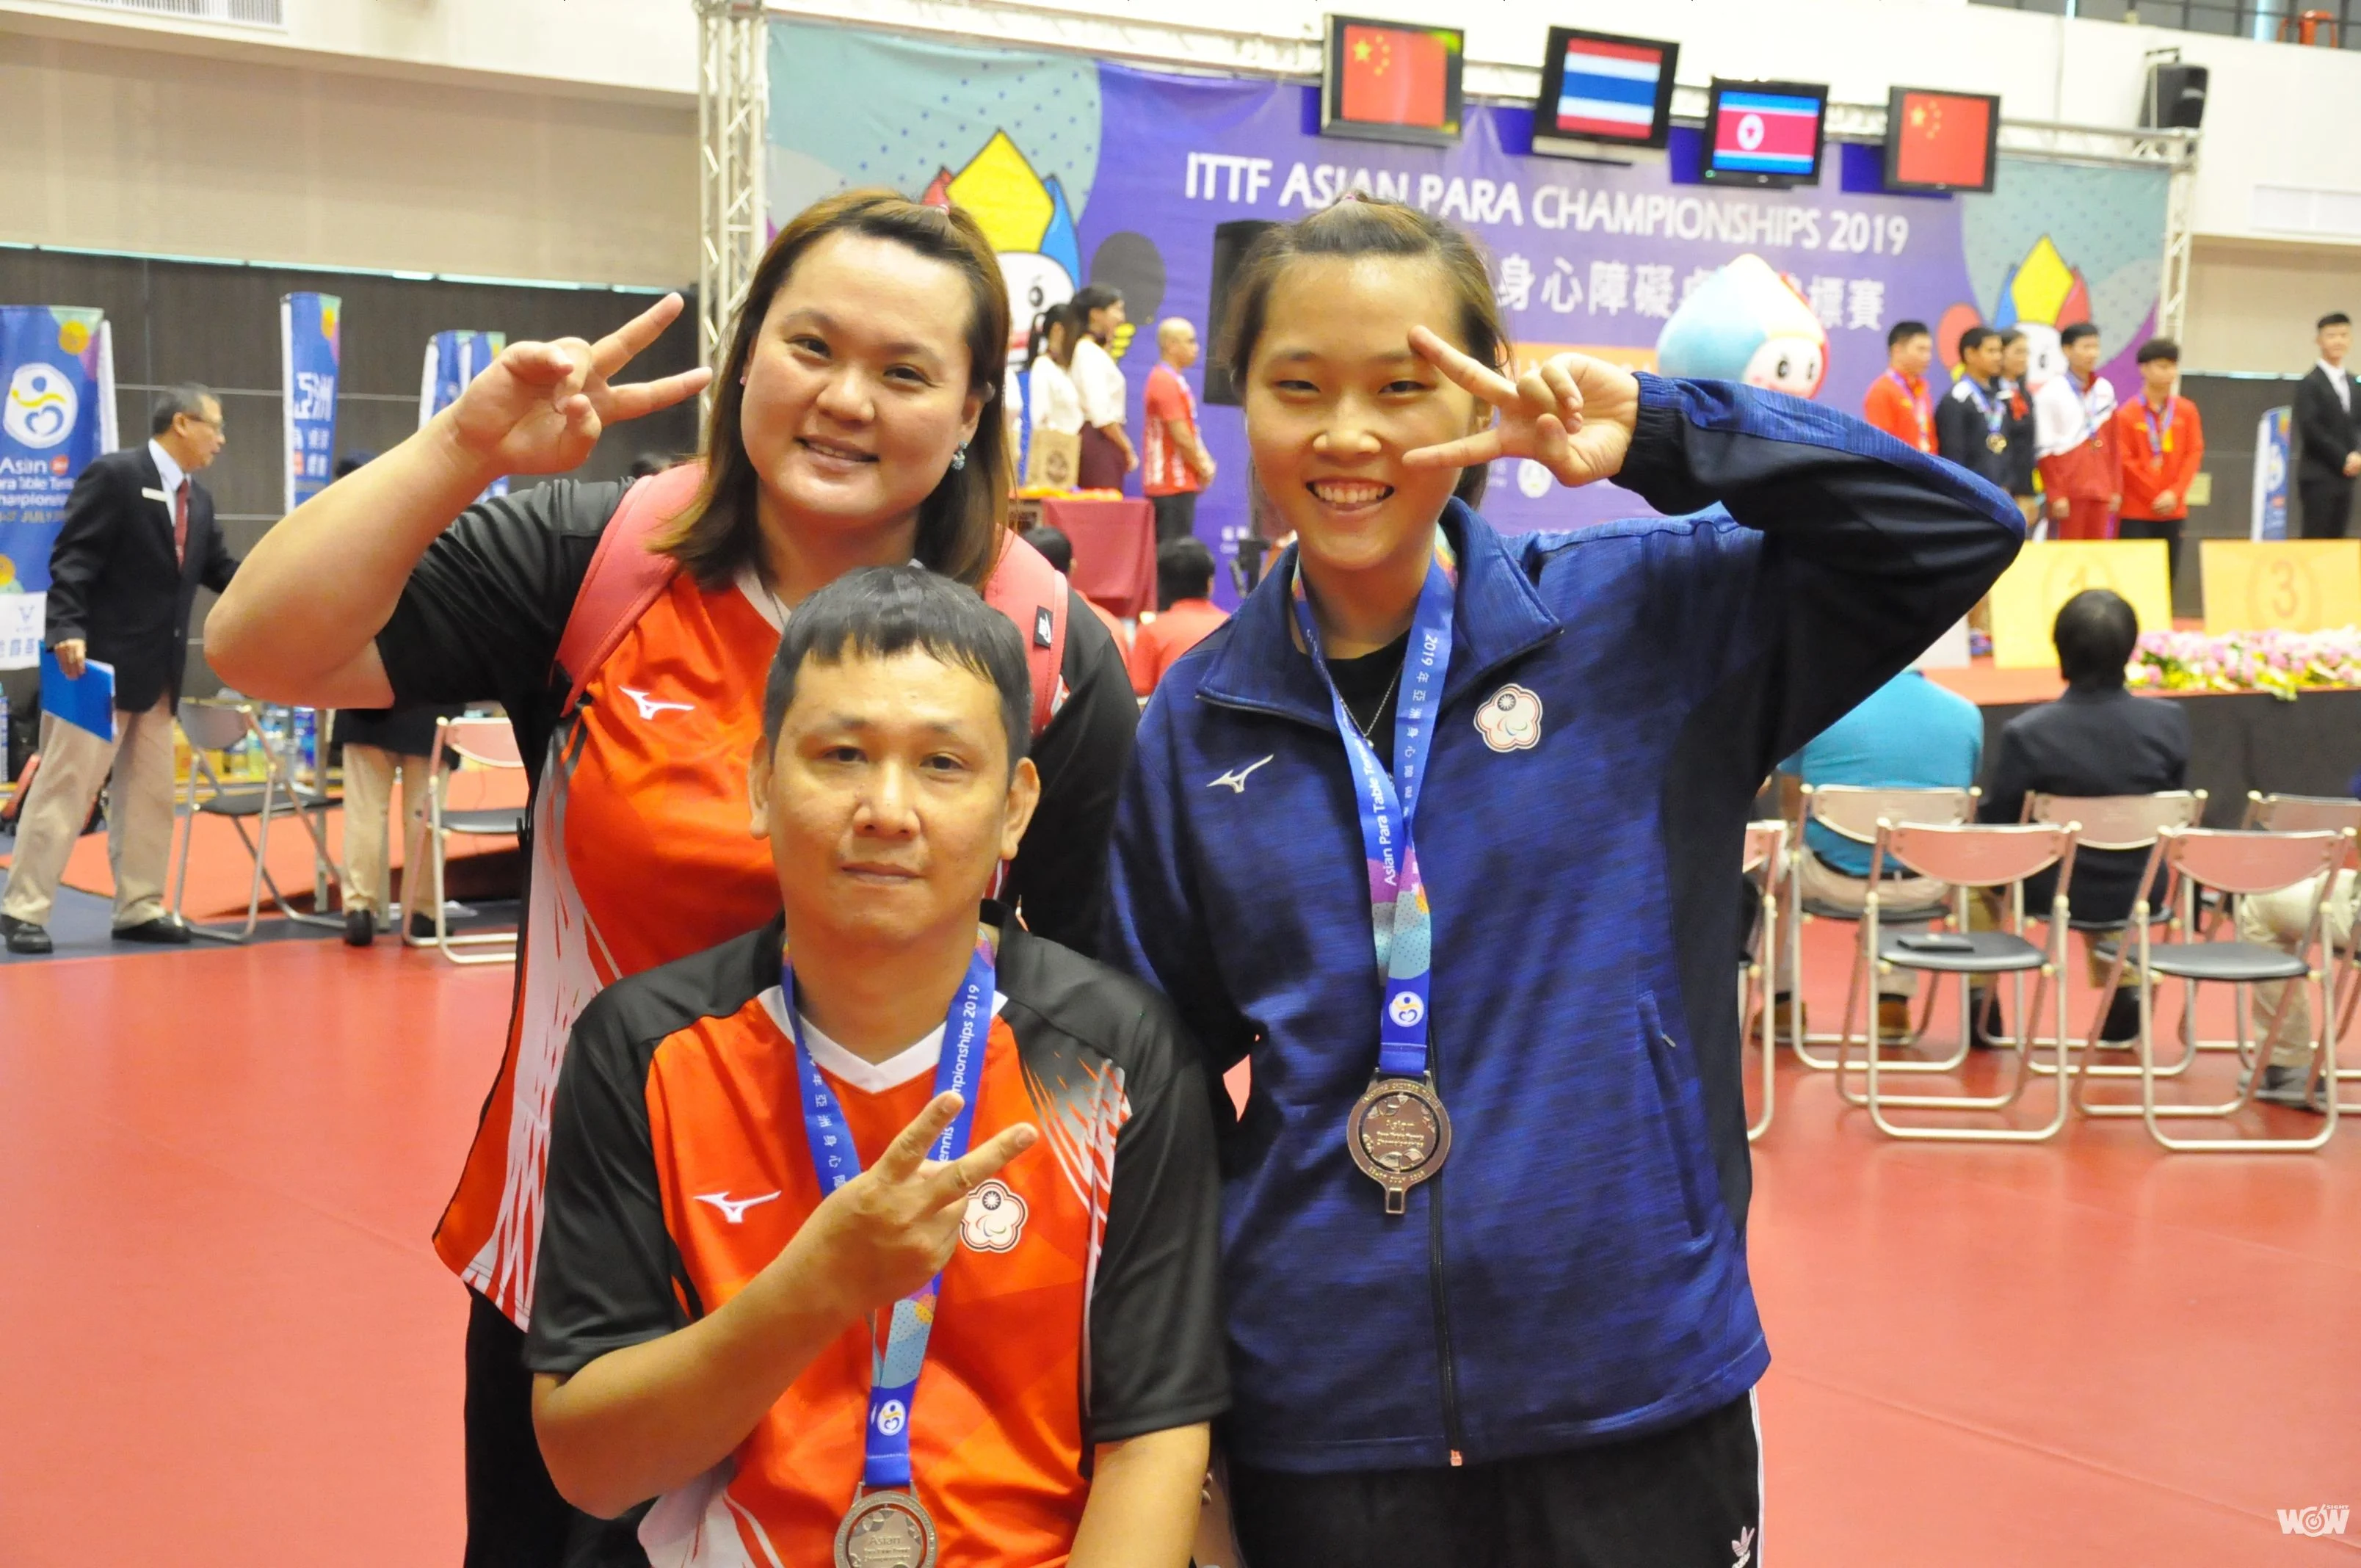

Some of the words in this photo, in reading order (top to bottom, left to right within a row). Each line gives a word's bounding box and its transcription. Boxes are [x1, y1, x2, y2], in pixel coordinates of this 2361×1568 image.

[1185, 151, 1273, 204] ITTF
[1278, 162, 1410, 209] ASIAN
[1419, 173, 1524, 226] PARA
[1531, 184, 1821, 250] CHAMPIONSHIPS
[1827, 210, 1909, 255] 2019
[1368, 776, 1386, 814] Table
[1377, 814, 1391, 845] Para
[1383, 848, 1397, 887] Asian
[938, 1125, 954, 1162] ennis
[951, 1021, 975, 1093] mpionships
[963, 984, 981, 1019] 2019
